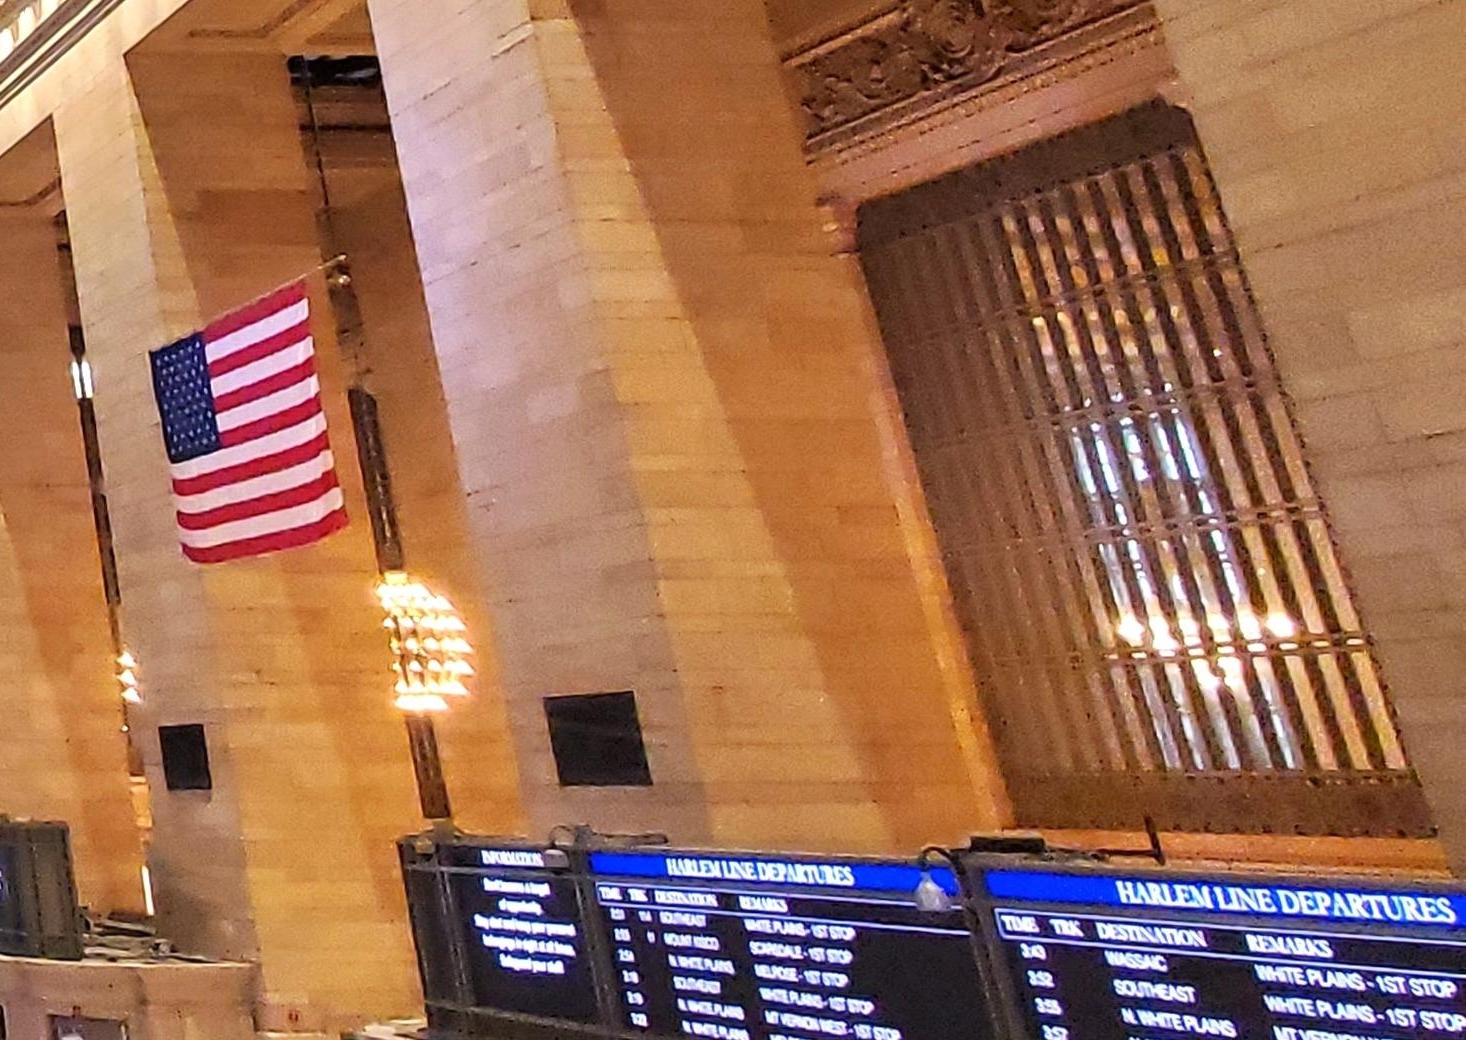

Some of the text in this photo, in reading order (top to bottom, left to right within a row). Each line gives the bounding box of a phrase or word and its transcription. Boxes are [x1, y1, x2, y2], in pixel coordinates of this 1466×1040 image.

[666, 859, 854, 885] HARLEM LINE DEPARTURES
[1116, 881, 1457, 923] HARLEM LINE DEPARTURES
[1001, 915, 1333, 958] TIME TRK DESTINATION REMARKS
[1104, 951, 1168, 972] WASSAIC
[1254, 964, 1306, 985] WHITE
[1307, 969, 1366, 991] PLAINS
[1376, 975, 1406, 994] 1ST
[1409, 977, 1457, 998] STOP
[1113, 979, 1195, 1003] SOUTHEAST
[1263, 995, 1316, 1017] WHITE
[1316, 1000, 1376, 1023] PLAINS
[1386, 1008, 1416, 1027] 1ST
[1419, 1010, 1466, 1031] STOP
[1137, 1010, 1184, 1031] WHITE
[1184, 1015, 1236, 1038] PLAINS
